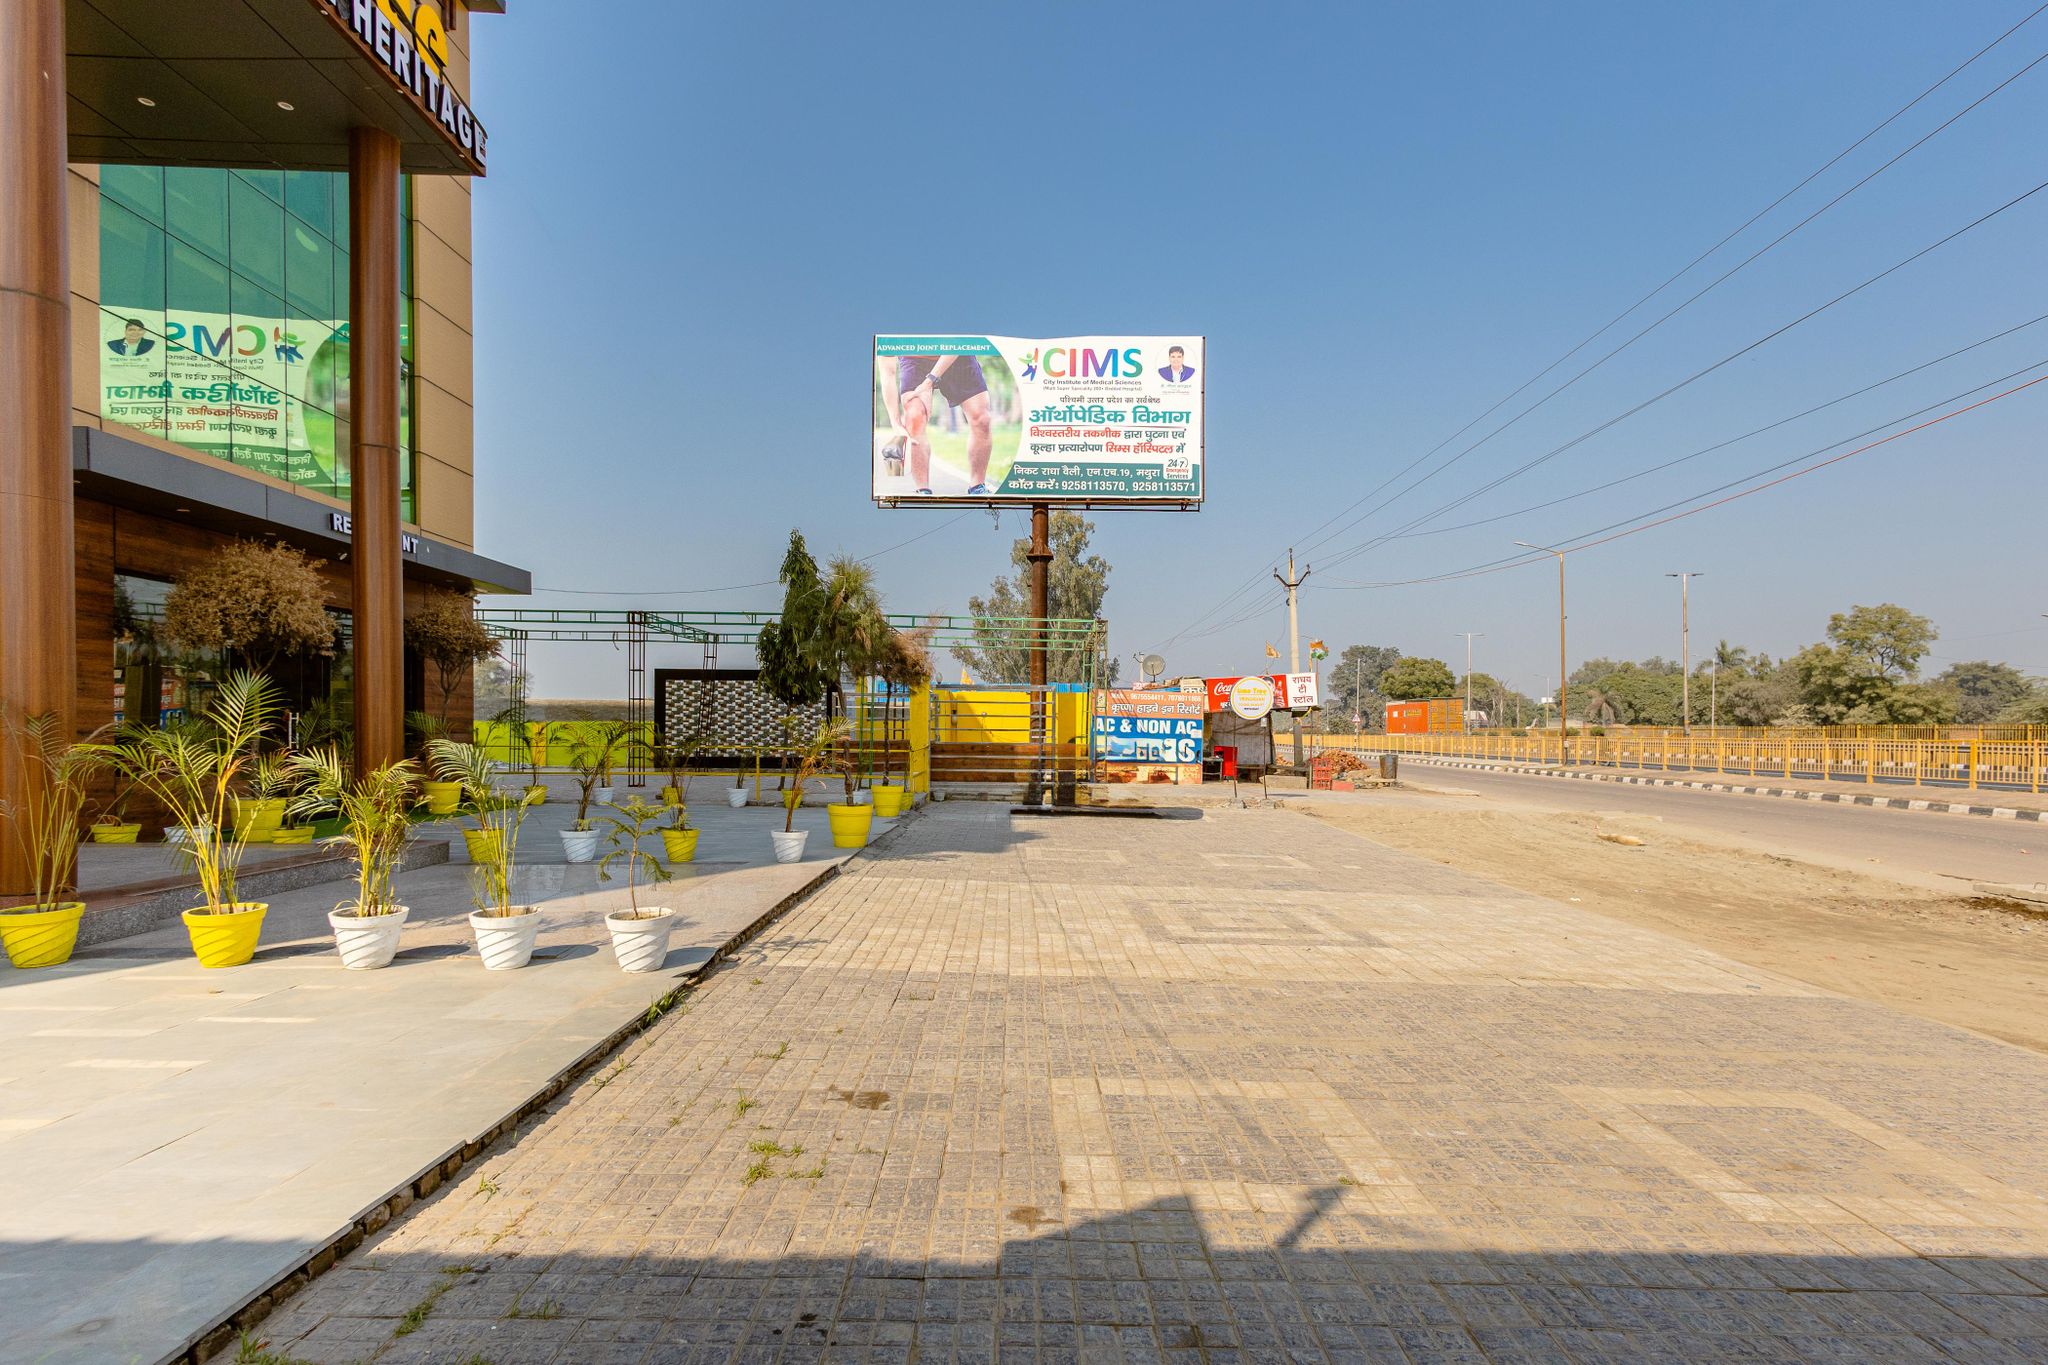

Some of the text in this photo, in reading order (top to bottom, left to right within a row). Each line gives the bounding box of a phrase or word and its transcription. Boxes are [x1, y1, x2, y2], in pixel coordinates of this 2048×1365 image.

[351, 0, 487, 167] HERITAGE
[917, 344, 938, 352] JOINT
[1043, 348, 1143, 378] CIMS
[1029, 404, 1191, 424] ऑर्थोपेडिक विभाग
[1030, 426, 1187, 443] विश्वस्तरीय तकनीक द्वारा घुटना एवं
[1030, 441, 1186, 455] कूल्हा प्रत्यारोपण सिम्स हॉस्पिटल में
[1013, 464, 1039, 476] निकट
[1136, 468, 1160, 480] मथुरा
[1008, 478, 1034, 490] कॉल
[1132, 481, 1195, 491] 9258113571
[1298, 686, 1307, 694] टी
[1161, 704, 1175, 714] इन
[1093, 717, 1198, 735] AC & NON AC
